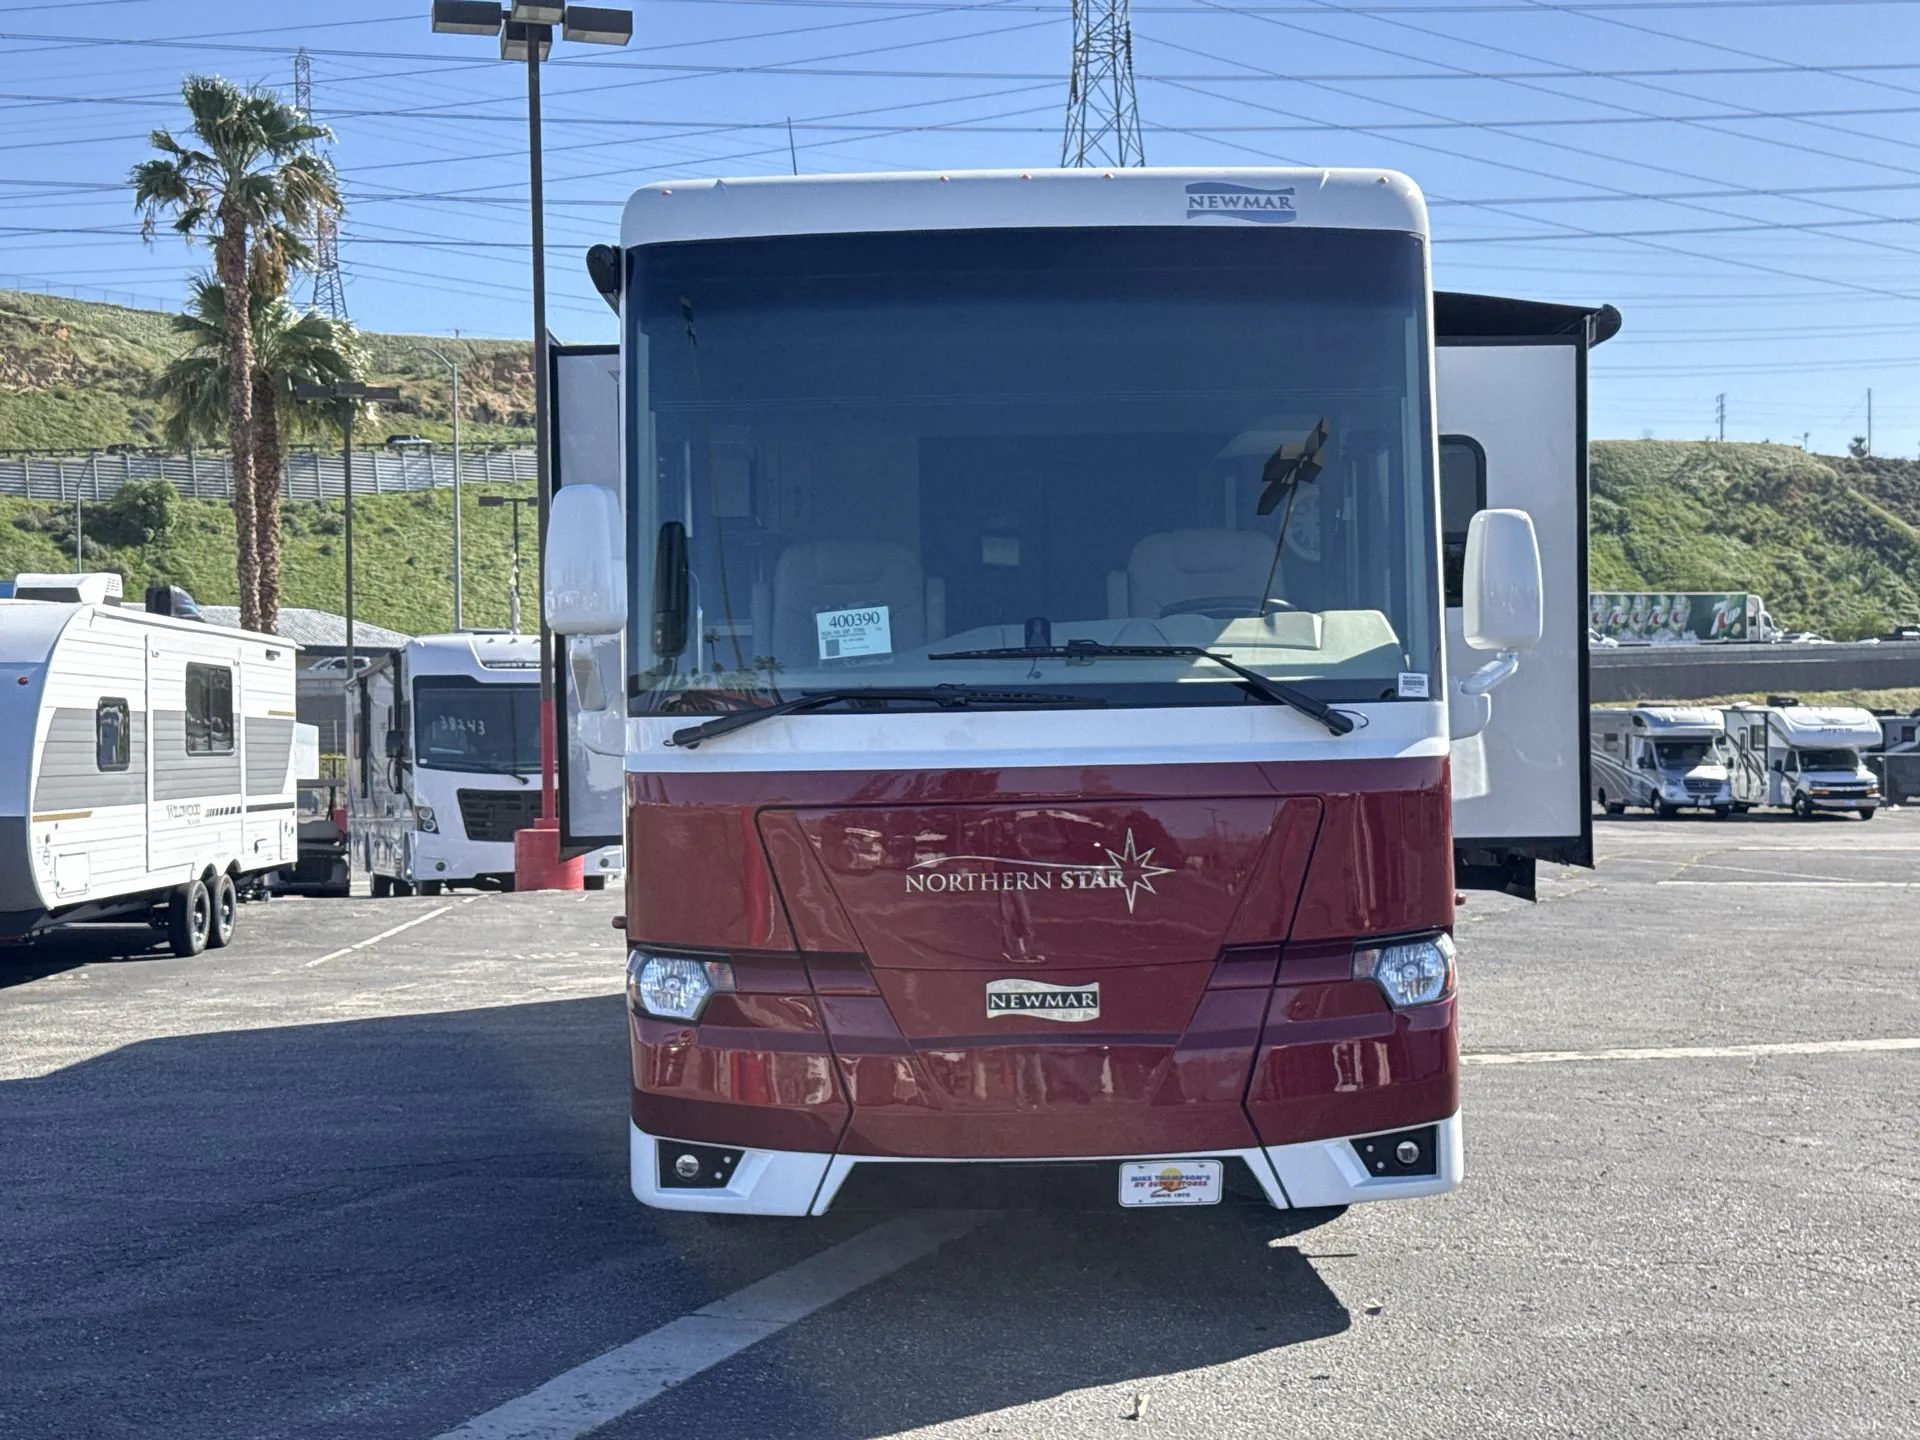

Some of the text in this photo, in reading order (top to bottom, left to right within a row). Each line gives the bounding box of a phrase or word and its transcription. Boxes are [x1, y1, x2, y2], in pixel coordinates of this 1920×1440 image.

[1188, 195, 1294, 210] NEWMAR
[829, 611, 881, 628] 400390
[440, 716, 486, 736] 38243
[905, 870, 1128, 893] NORTHERN STAR
[990, 993, 1096, 1008] NEWMAR
